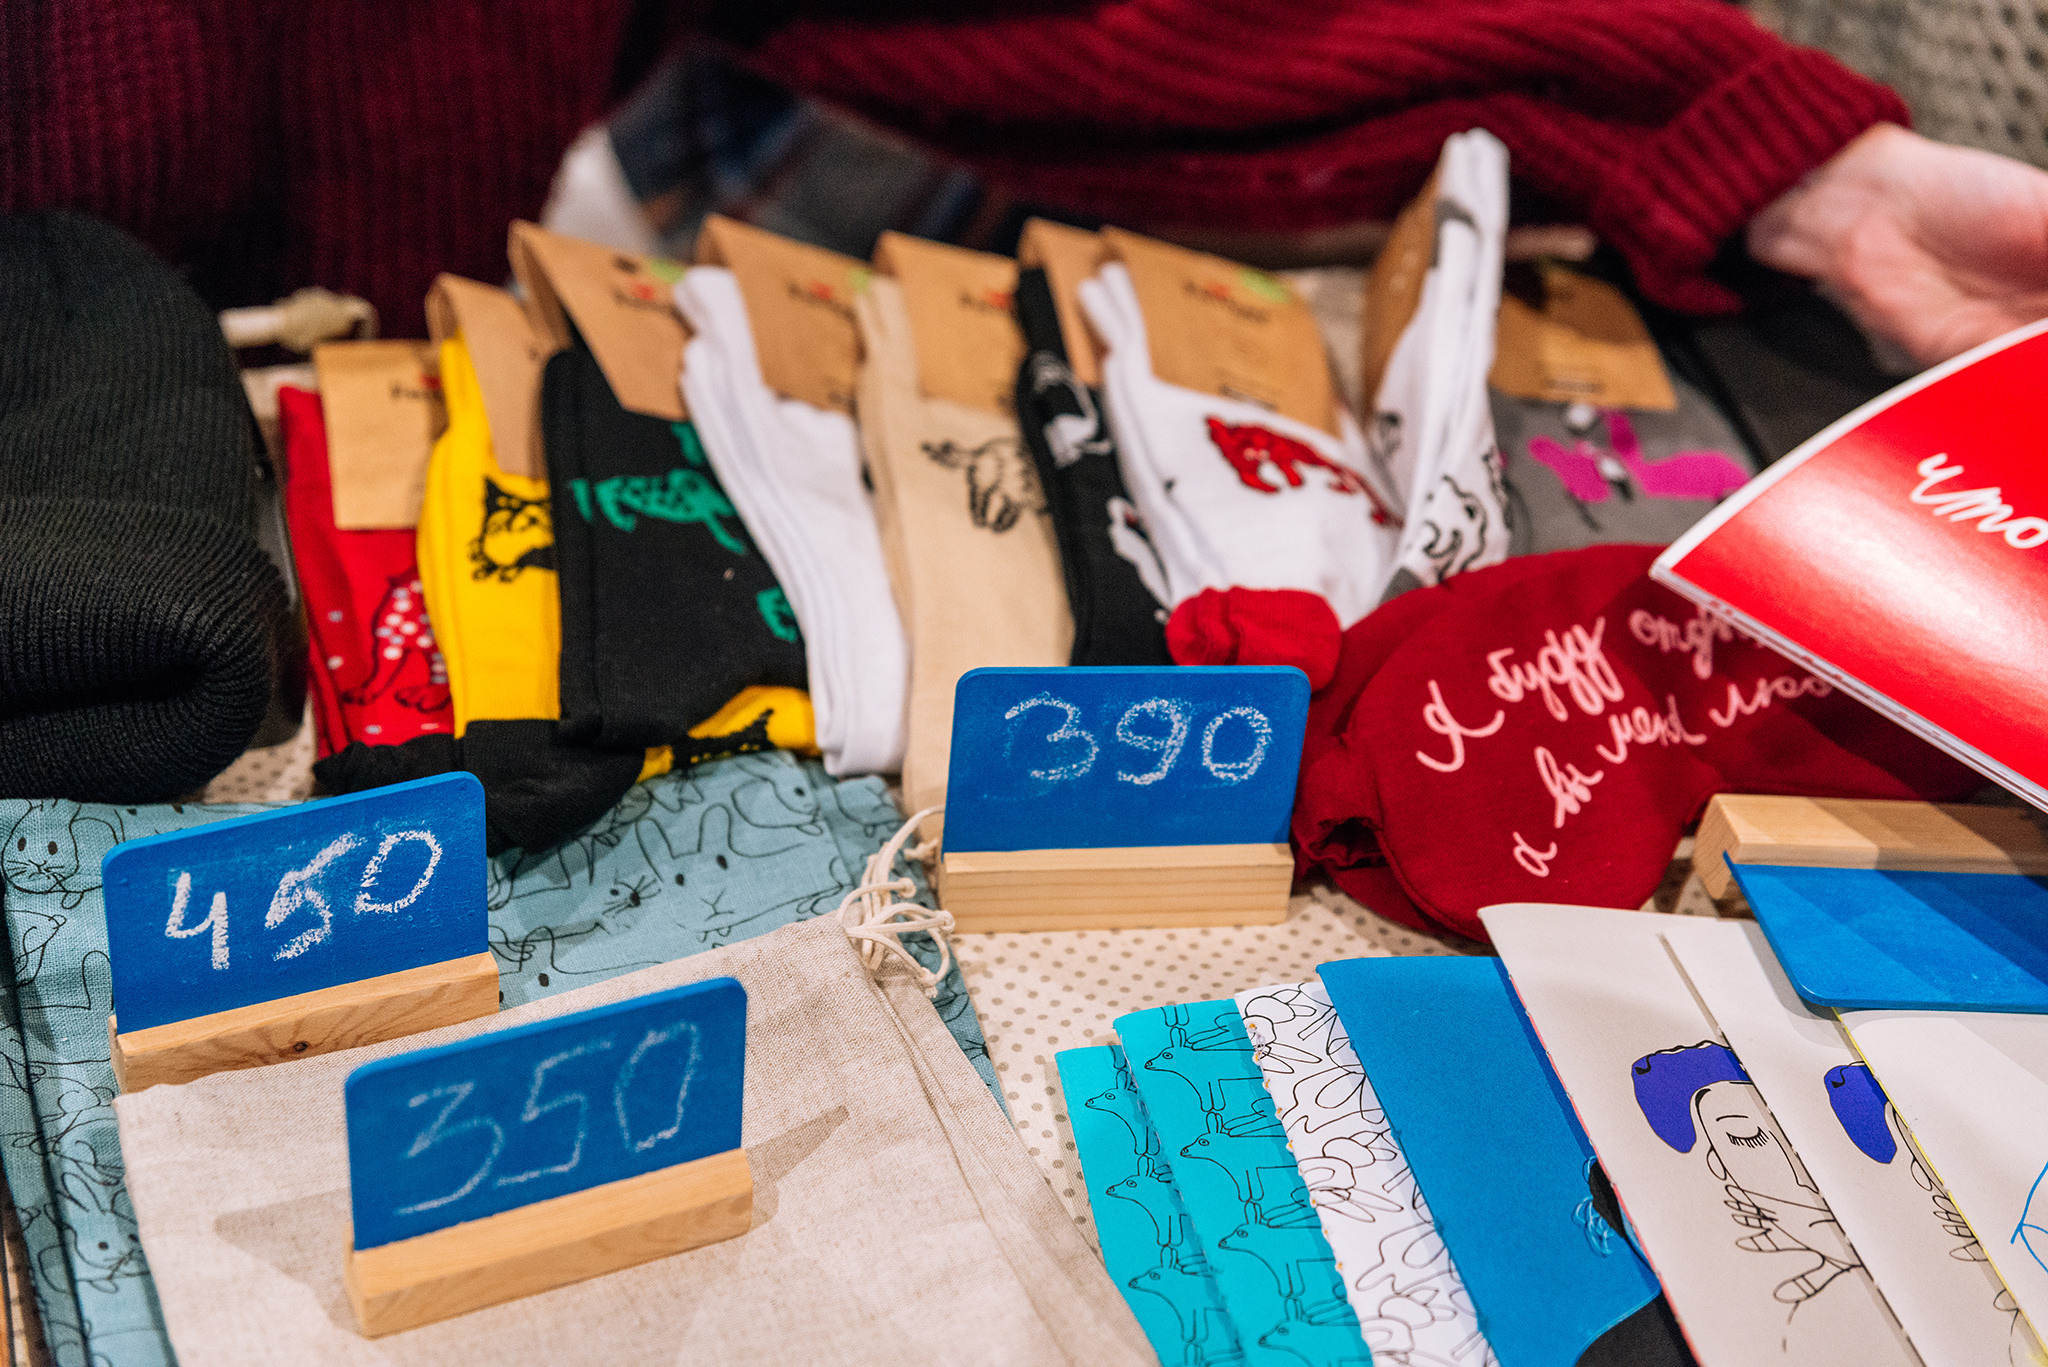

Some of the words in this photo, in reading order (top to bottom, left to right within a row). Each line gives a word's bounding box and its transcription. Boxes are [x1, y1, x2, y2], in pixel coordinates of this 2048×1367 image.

[1004, 694, 1272, 785] 390
[1416, 680, 1505, 772] Я
[1487, 616, 1624, 722] буду
[1596, 694, 1707, 764] меня
[1534, 746, 1605, 828] вы
[1513, 831, 1557, 877] а
[164, 830, 443, 970] 450
[394, 1020, 702, 1216] 350
